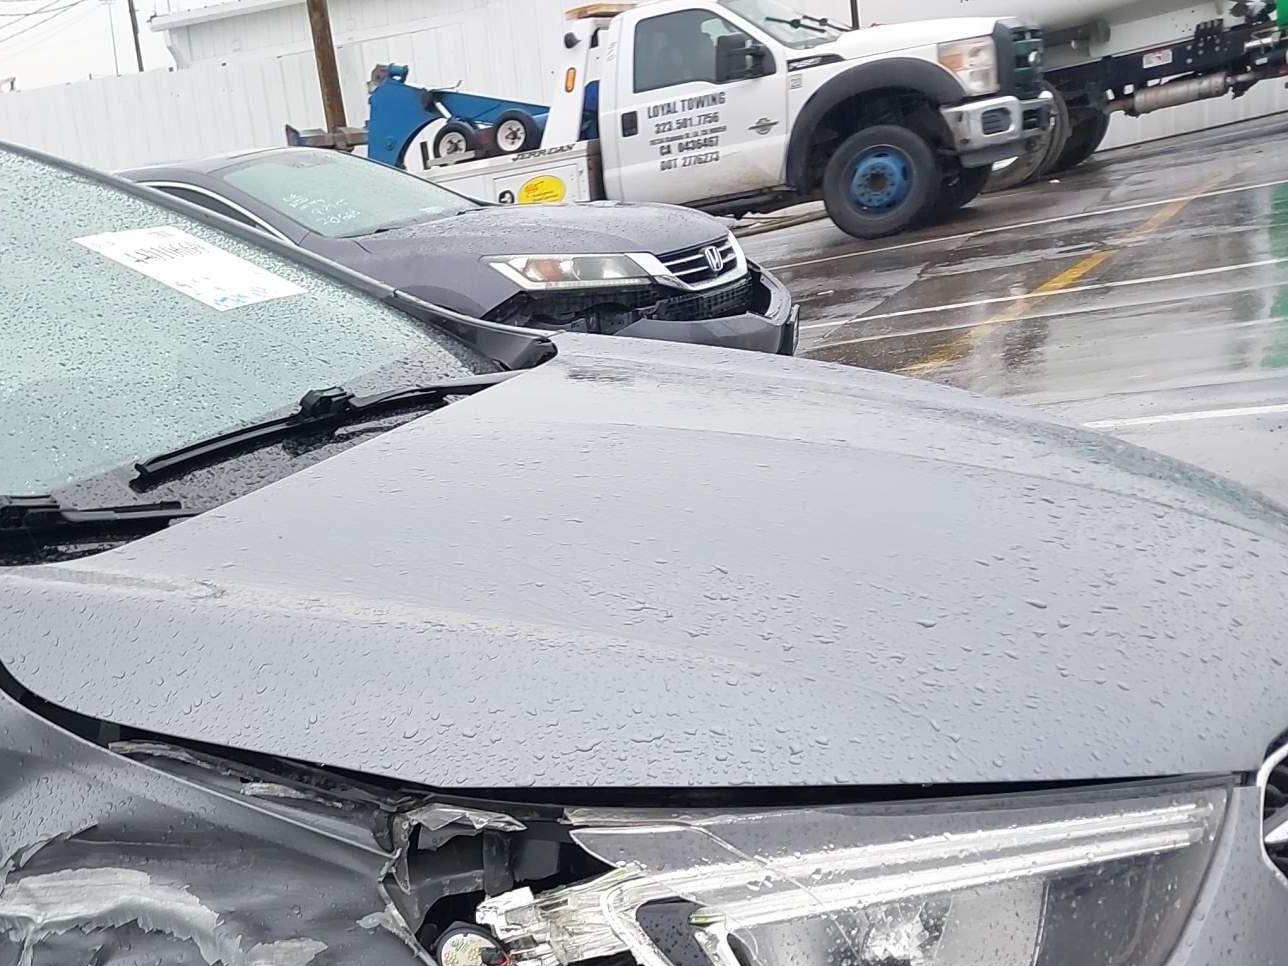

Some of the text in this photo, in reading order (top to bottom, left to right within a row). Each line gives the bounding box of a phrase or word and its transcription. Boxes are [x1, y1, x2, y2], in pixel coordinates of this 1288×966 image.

[648, 91, 726, 119] LOYAL TOWING
[659, 144, 672, 156] CA
[660, 158, 678, 171] DOT
